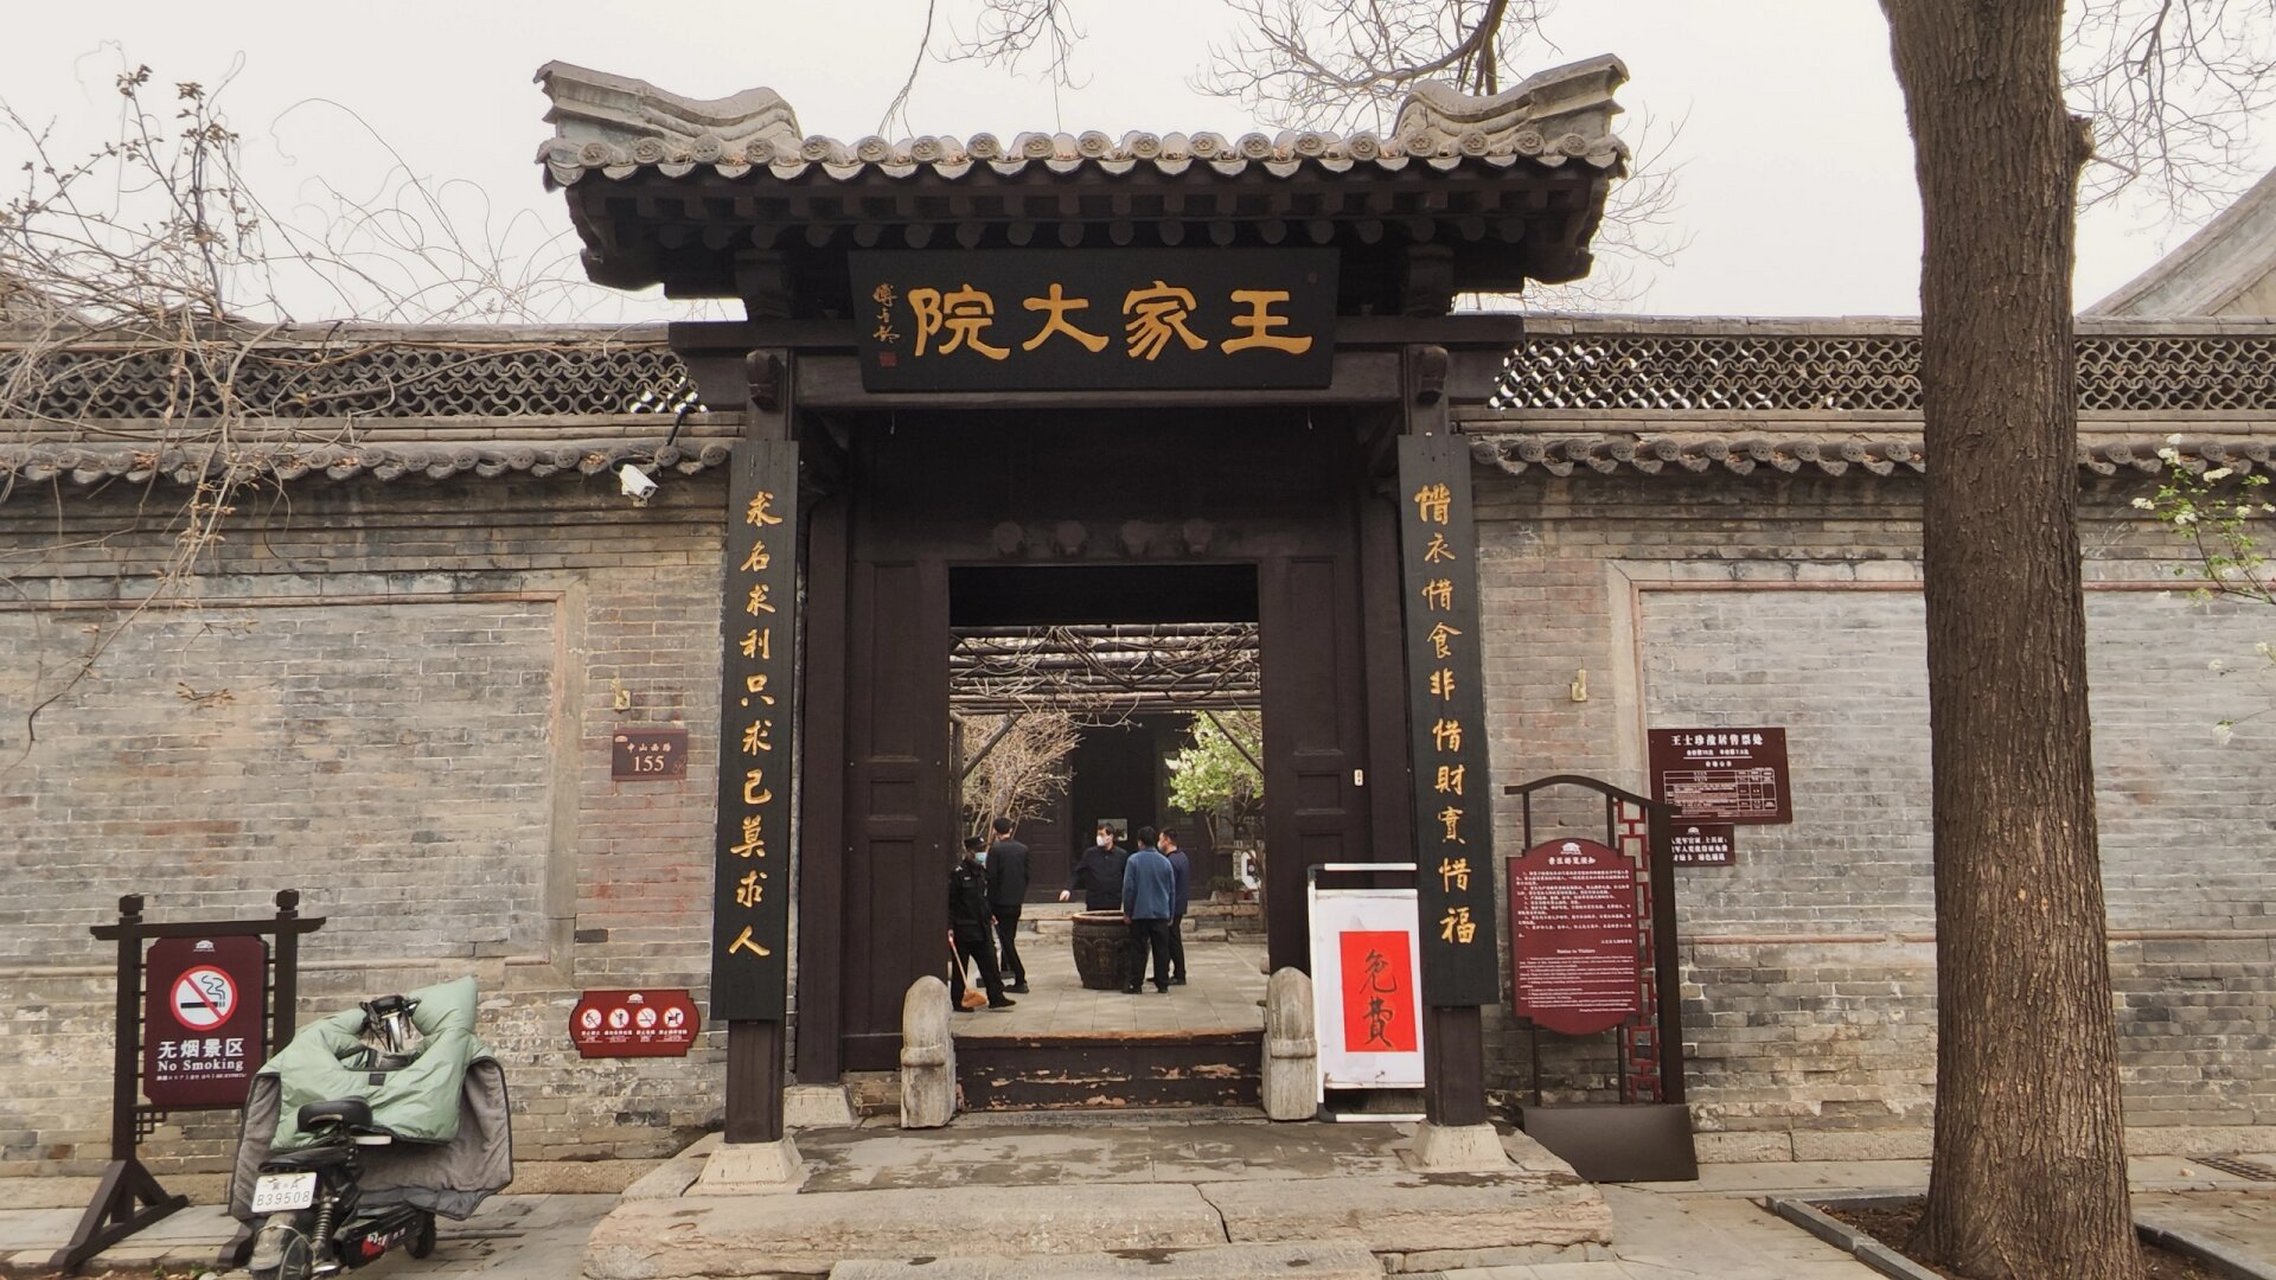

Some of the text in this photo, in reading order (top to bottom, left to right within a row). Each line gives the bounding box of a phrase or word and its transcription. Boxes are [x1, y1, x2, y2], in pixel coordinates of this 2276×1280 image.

[906, 280, 1313, 361] 王家大院
[729, 491, 783, 956] 求名求利只求己莫求人
[633, 755, 665, 772] 155
[157, 1038, 244, 1059] 无烟景区
[157, 1058, 244, 1072] No Smoking
